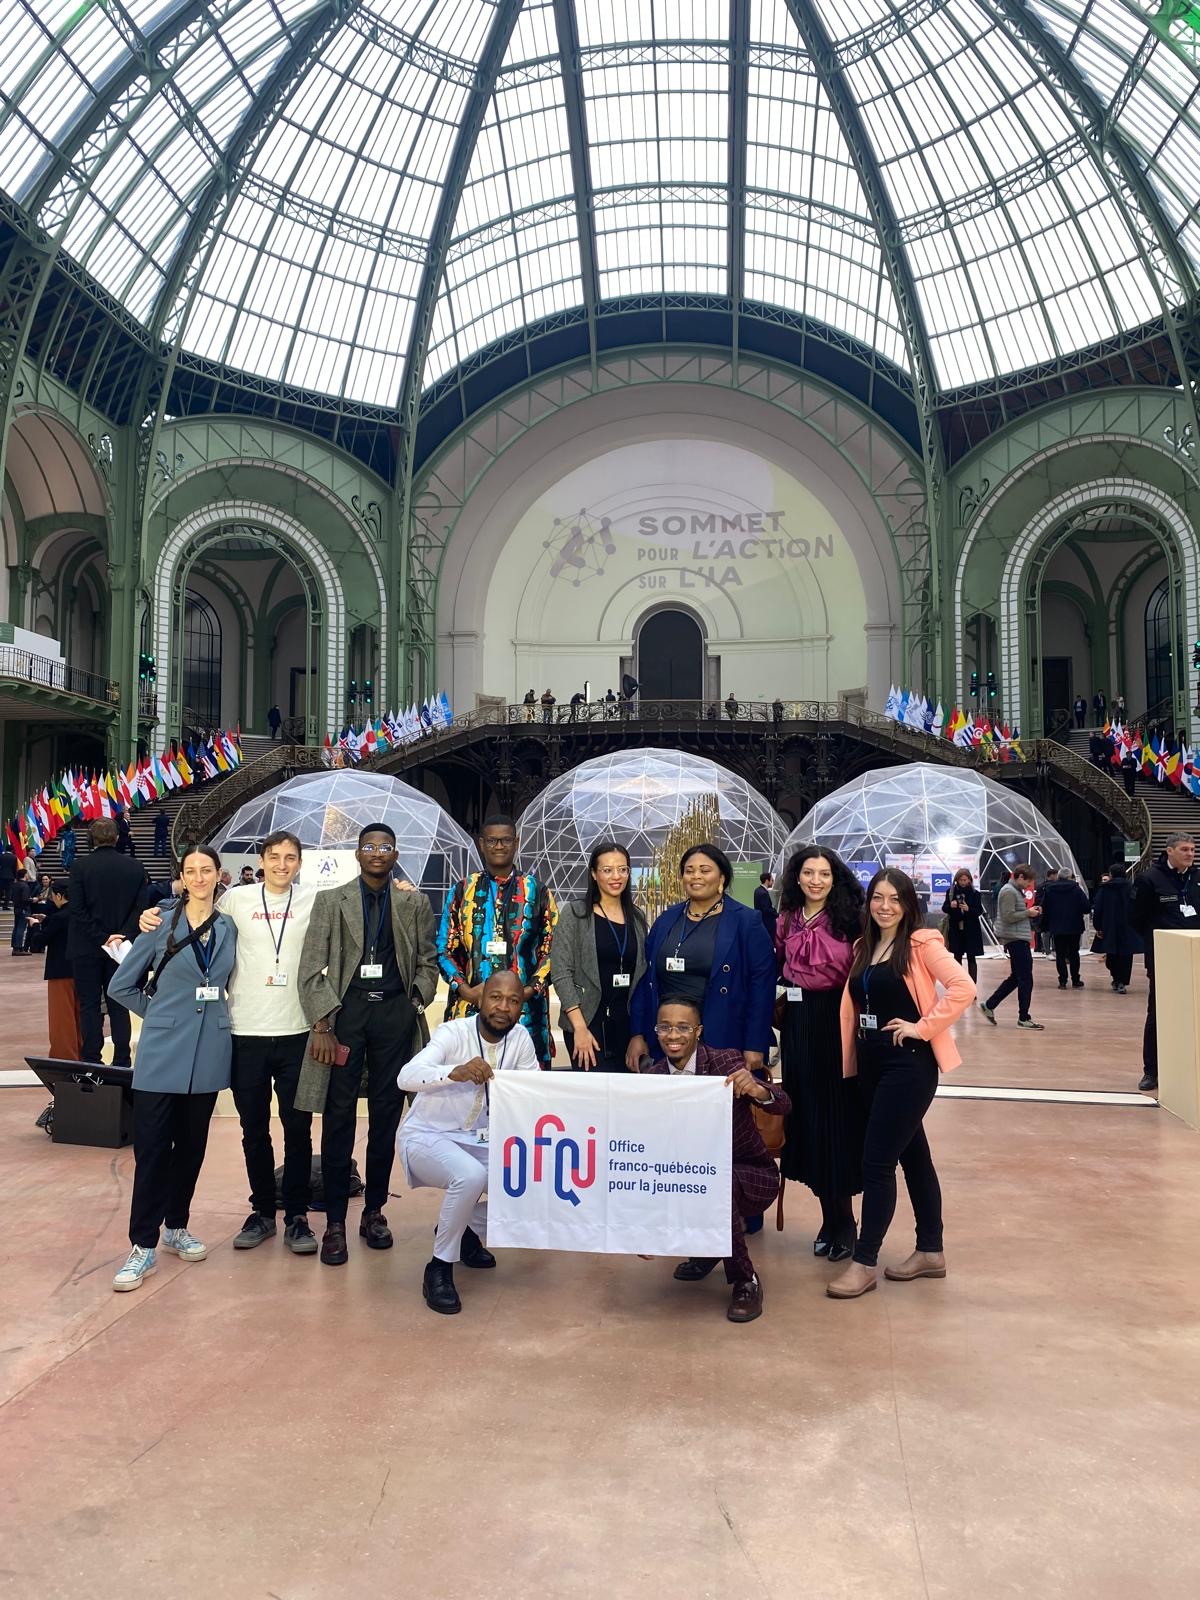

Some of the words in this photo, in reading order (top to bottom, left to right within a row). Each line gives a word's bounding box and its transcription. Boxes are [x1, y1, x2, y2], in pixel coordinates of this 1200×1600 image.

[638, 511, 785, 535] SOMMET
[637, 547, 679, 561] POUR
[692, 534, 834, 560] L'ACTION
[638, 575, 667, 589] SUR
[679, 566, 743, 588] L'IA
[609, 1140, 645, 1153] Office
[609, 1159, 717, 1175] franco-québécois
[609, 1180, 636, 1192] pour
[640, 1179, 650, 1191] la
[652, 1180, 707, 1195] jeunesse
